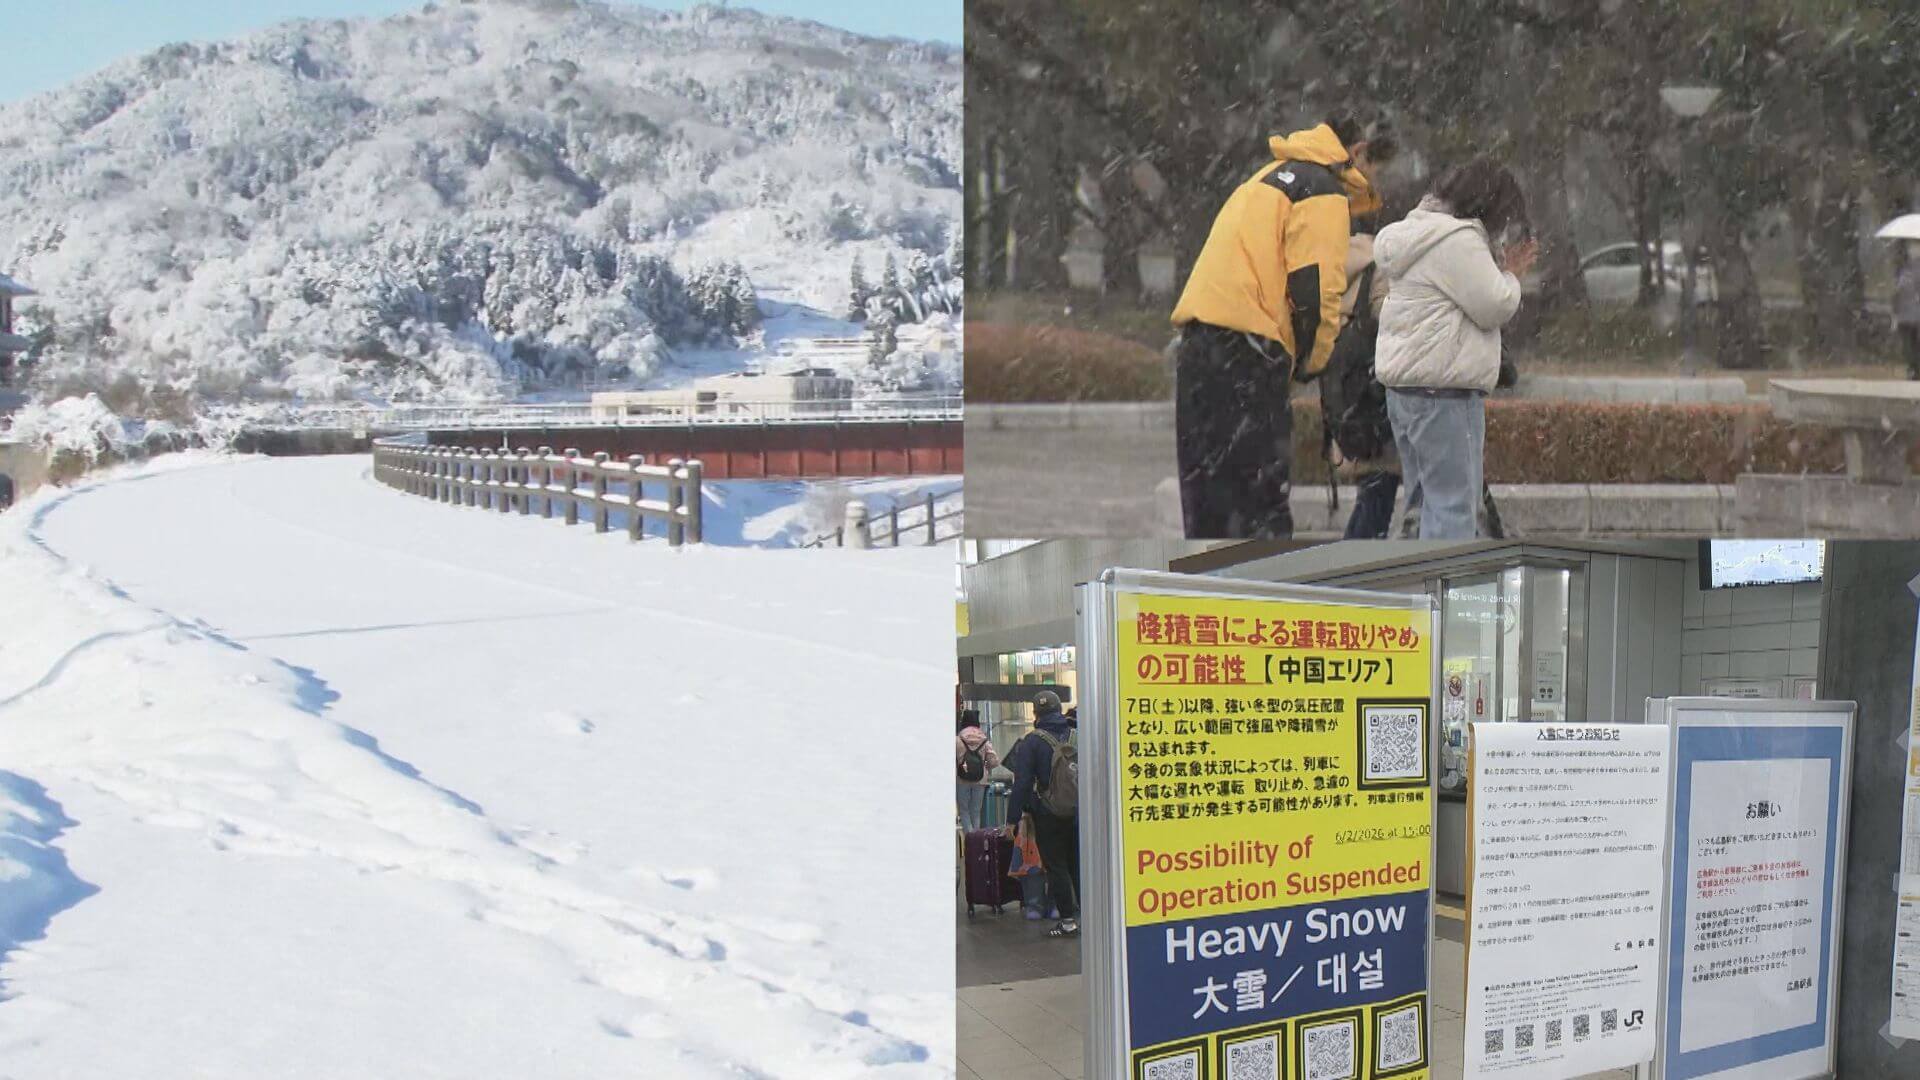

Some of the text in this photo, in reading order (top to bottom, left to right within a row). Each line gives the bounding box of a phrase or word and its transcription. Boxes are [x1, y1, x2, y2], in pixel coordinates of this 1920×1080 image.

[1137, 612, 1419, 649] 降積雪による運転取りやめ
[1128, 740, 1216, 757] 見込まれます。
[1129, 793, 1358, 822] 行先変更が発生する可能性があります。
[1745, 801, 1782, 819] お願い
[1388, 826, 1398, 837] at
[1138, 835, 1314, 874] Possibility of
[1138, 860, 1421, 917] Operation Suspended
[1166, 906, 1407, 964] Heavy Snow
[1623, 1010, 1644, 1028] JR
